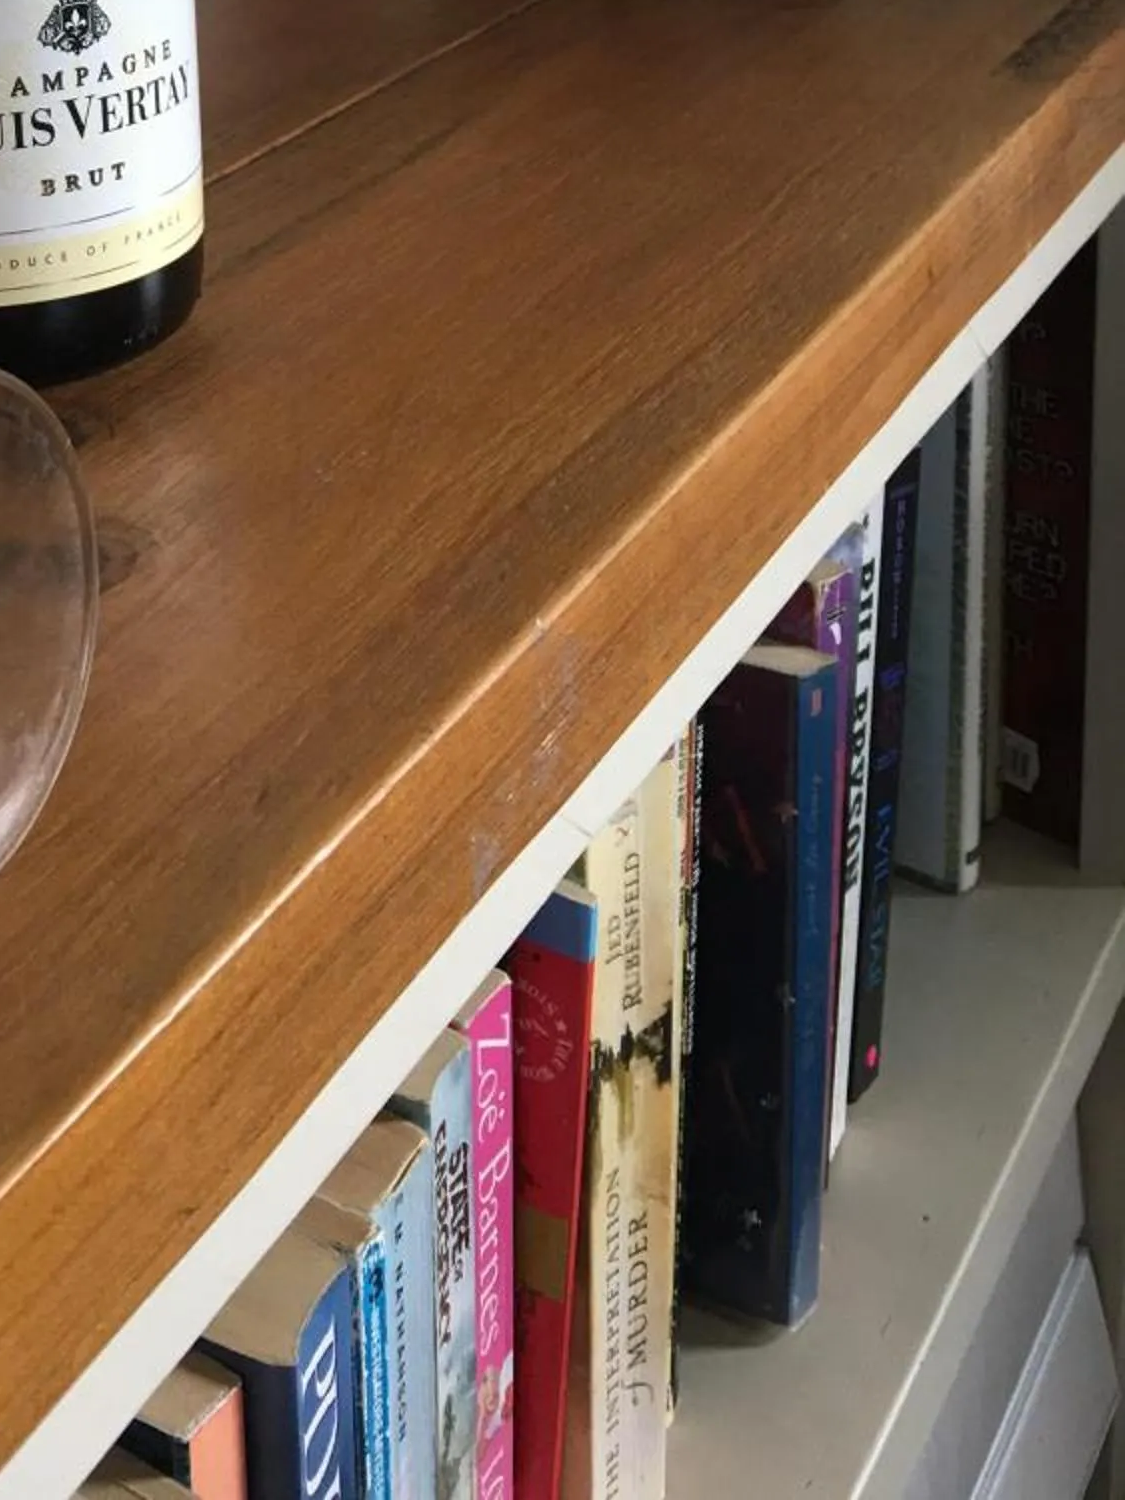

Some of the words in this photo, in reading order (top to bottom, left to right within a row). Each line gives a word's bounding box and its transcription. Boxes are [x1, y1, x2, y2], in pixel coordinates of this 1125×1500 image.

[63, 58, 191, 140] VERTAY
[41, 160, 127, 197] BRUT
[85, 242, 108, 257] OF
[124, 211, 181, 246] FRANCE
[605, 914, 623, 966] JED
[623, 851, 643, 1012] RUBENFELD
[476, 1013, 511, 1143] Zoë
[435, 1119, 452, 1347] EMERGENCY
[448, 1142, 470, 1250] STATE
[478, 1138, 512, 1357] Barnes
[395, 1260, 407, 1444] NATHANSON
[606, 1167, 620, 1435] INTERPRETATION
[627, 1209, 649, 1372] MURDER
[606, 1442, 620, 1500] THE
